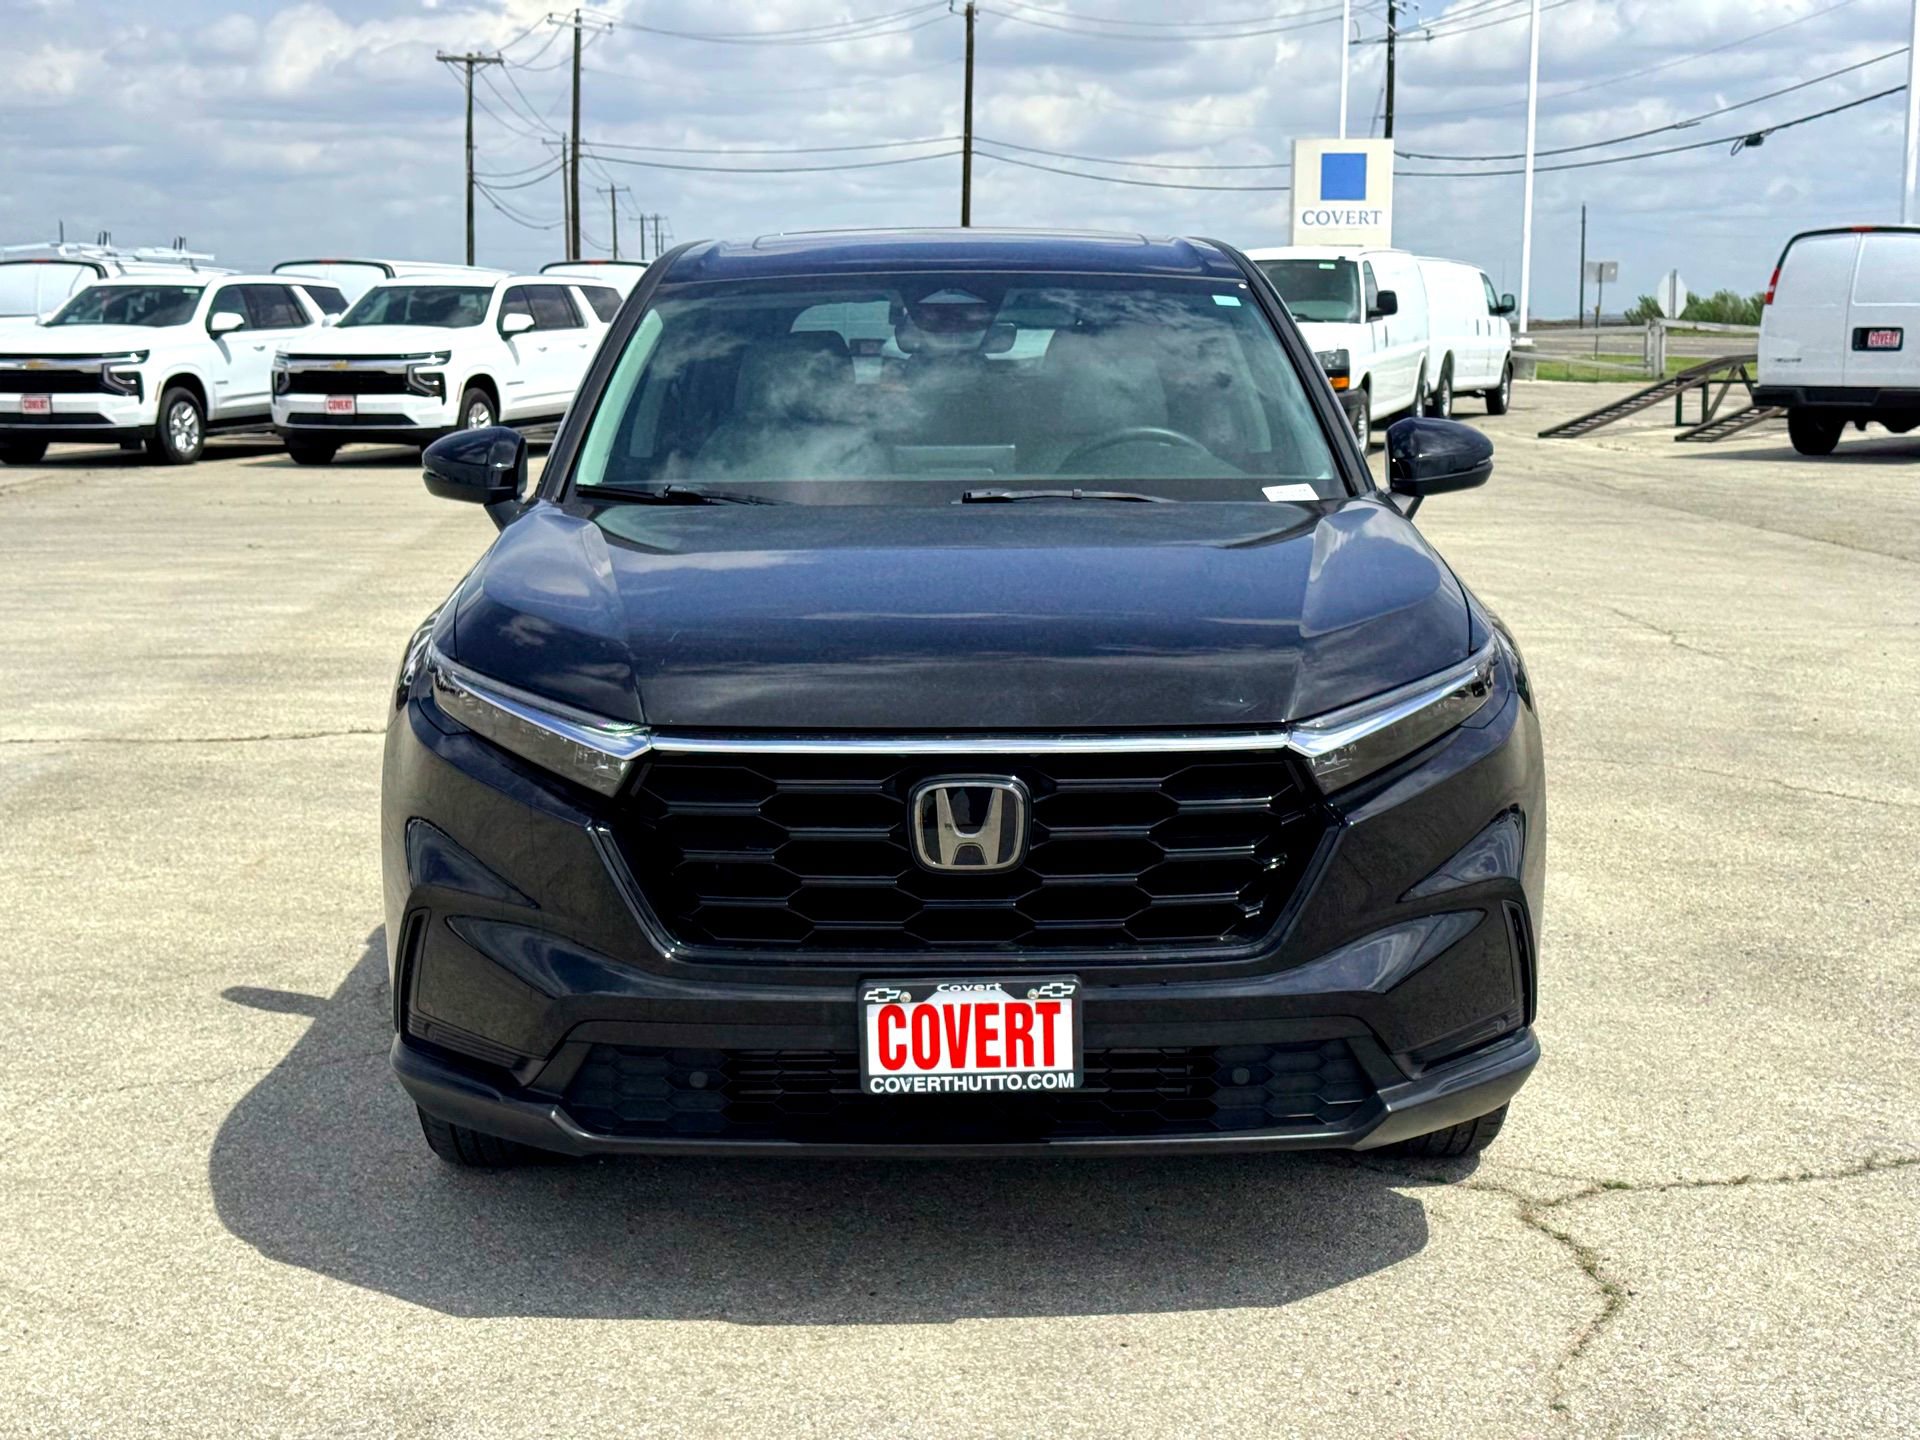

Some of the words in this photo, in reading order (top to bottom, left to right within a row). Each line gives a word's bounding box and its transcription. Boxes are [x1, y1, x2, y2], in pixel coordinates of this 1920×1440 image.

[1302, 210, 1383, 226] COVERT
[936, 983, 1002, 993] Covert
[877, 1001, 1062, 1071] COVERT
[869, 1072, 1075, 1094] COVERTHUTTO.COM
